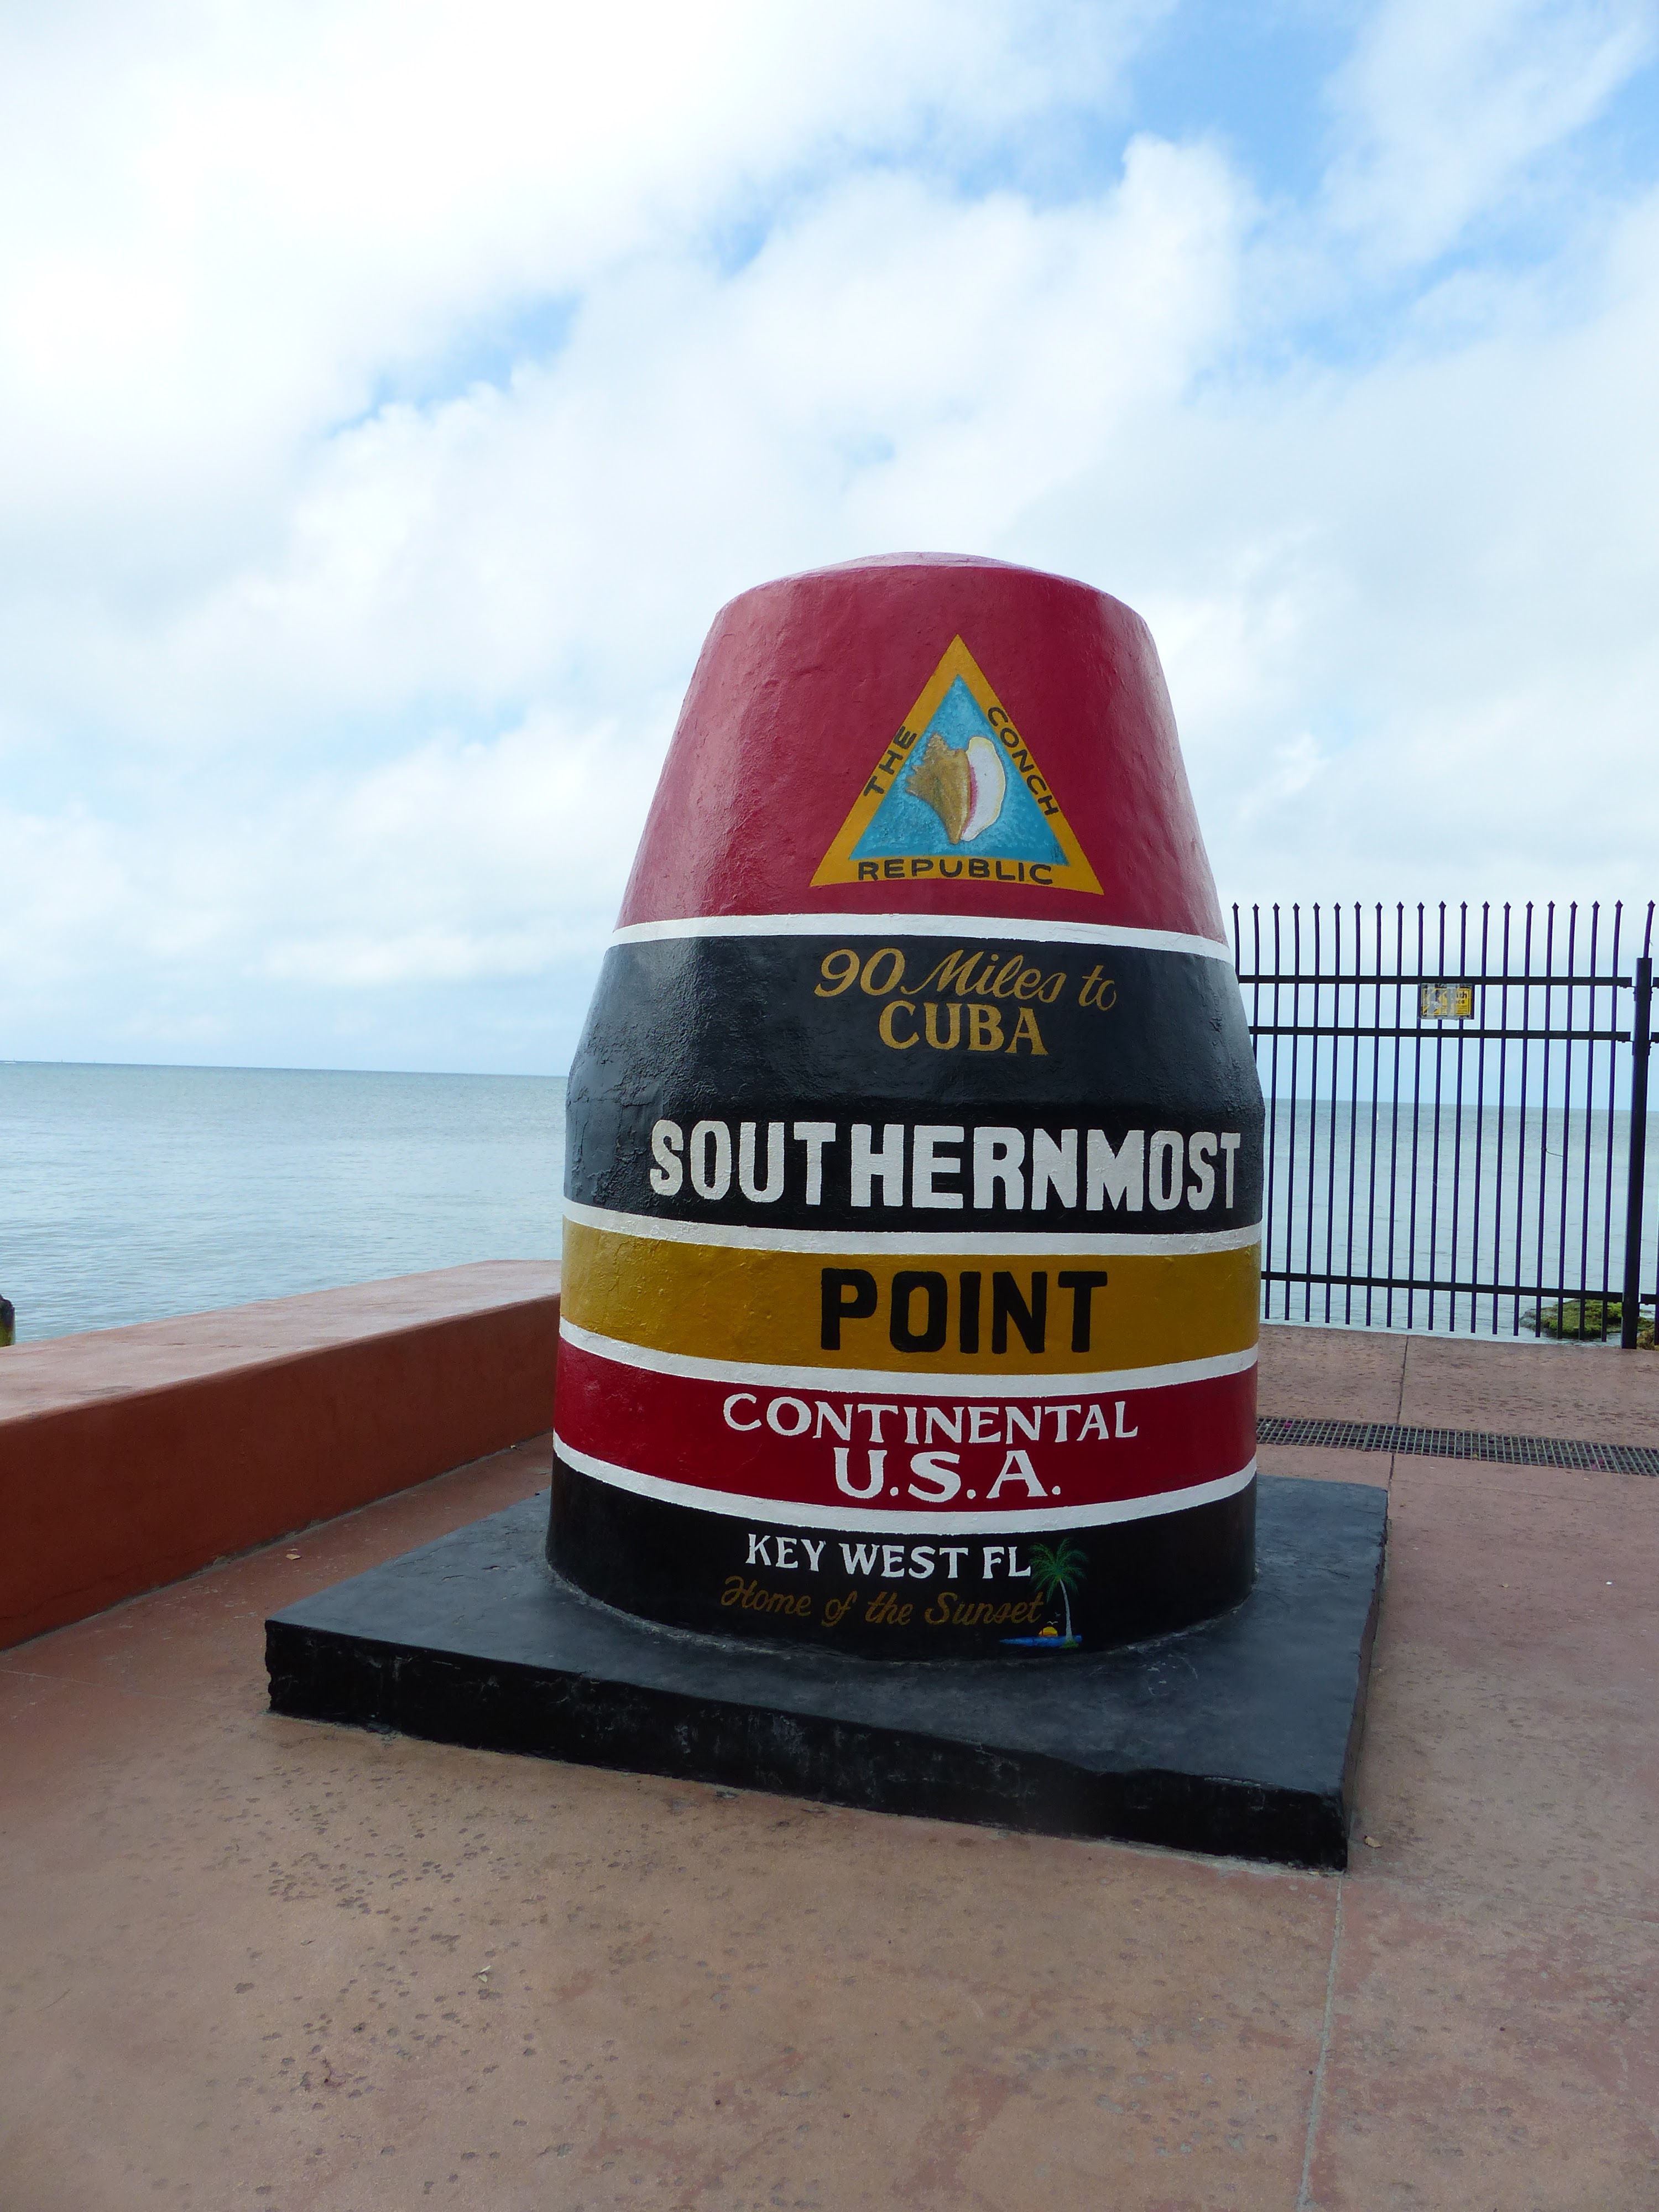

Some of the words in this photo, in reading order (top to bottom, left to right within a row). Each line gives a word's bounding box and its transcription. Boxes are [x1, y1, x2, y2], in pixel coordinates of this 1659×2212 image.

[863, 726, 916, 796] THE
[988, 707, 1059, 816] CONCH
[858, 859, 1053, 885] REPUBLIC
[814, 948, 905, 997] 90
[900, 949, 1067, 1003] Miles
[1078, 965, 1117, 1010] to
[879, 1000, 1049, 1055] CUBA
[650, 1120, 1240, 1212] SOUTHERNMOST
[820, 1267, 1107, 1354] POINT
[723, 1392, 1138, 1444] CONTINENTAL
[833, 1447, 1061, 1503] U.S.A.
[745, 1533, 826, 1572] KEY
[838, 1542, 968, 1579] WEST
[982, 1546, 1031, 1579] FL
[721, 1575, 811, 1616] Home
[820, 1591, 857, 1626] of
[865, 1592, 911, 1625] the
[924, 1592, 1043, 1626] Sunset
